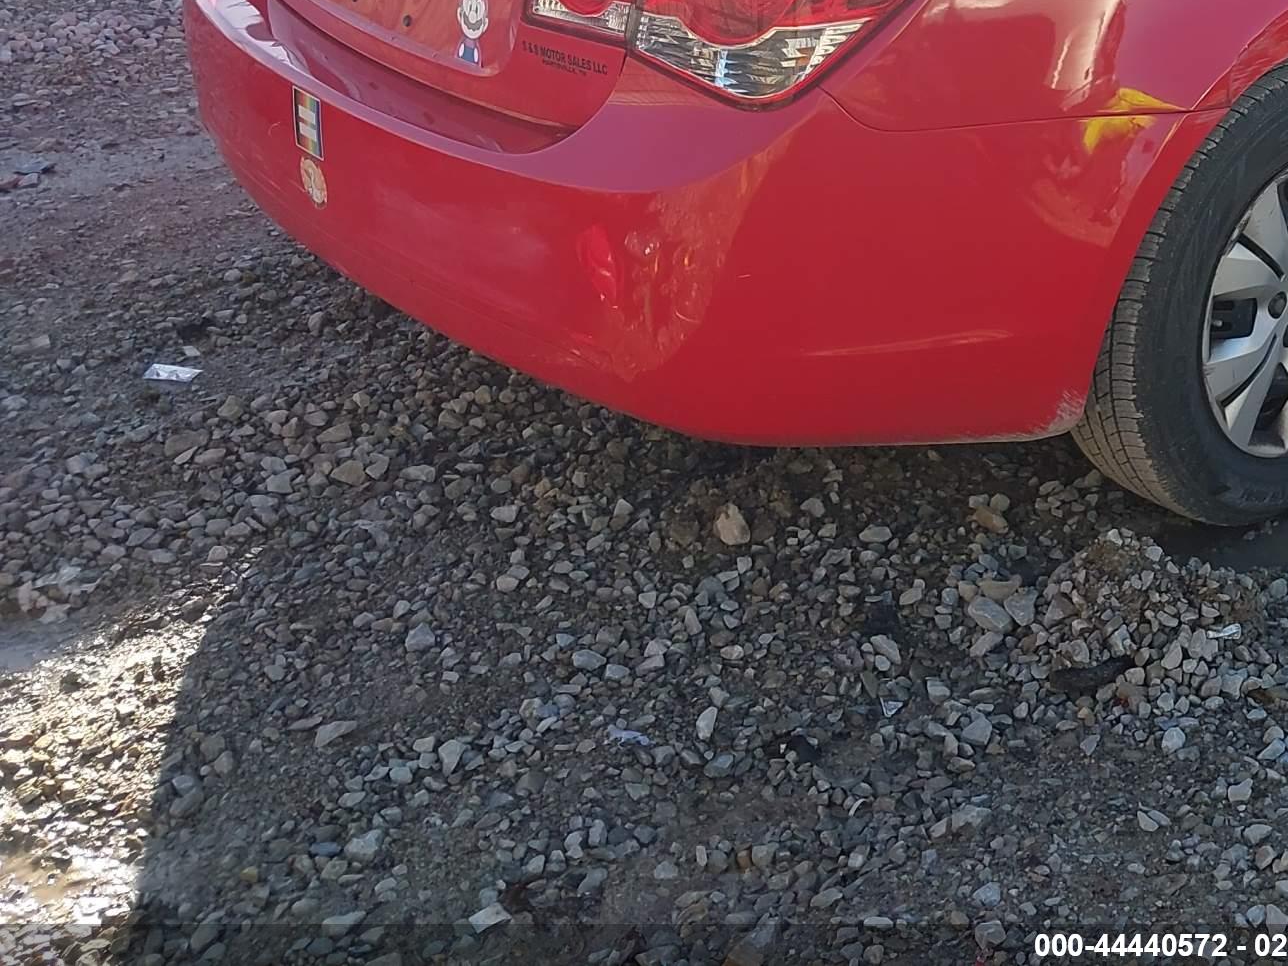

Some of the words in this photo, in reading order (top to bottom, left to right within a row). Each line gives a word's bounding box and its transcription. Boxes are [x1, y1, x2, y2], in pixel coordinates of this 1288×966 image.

[540, 46, 566, 63] MOTOR
[567, 54, 592, 70] SALES
[593, 61, 608, 75] LLC
